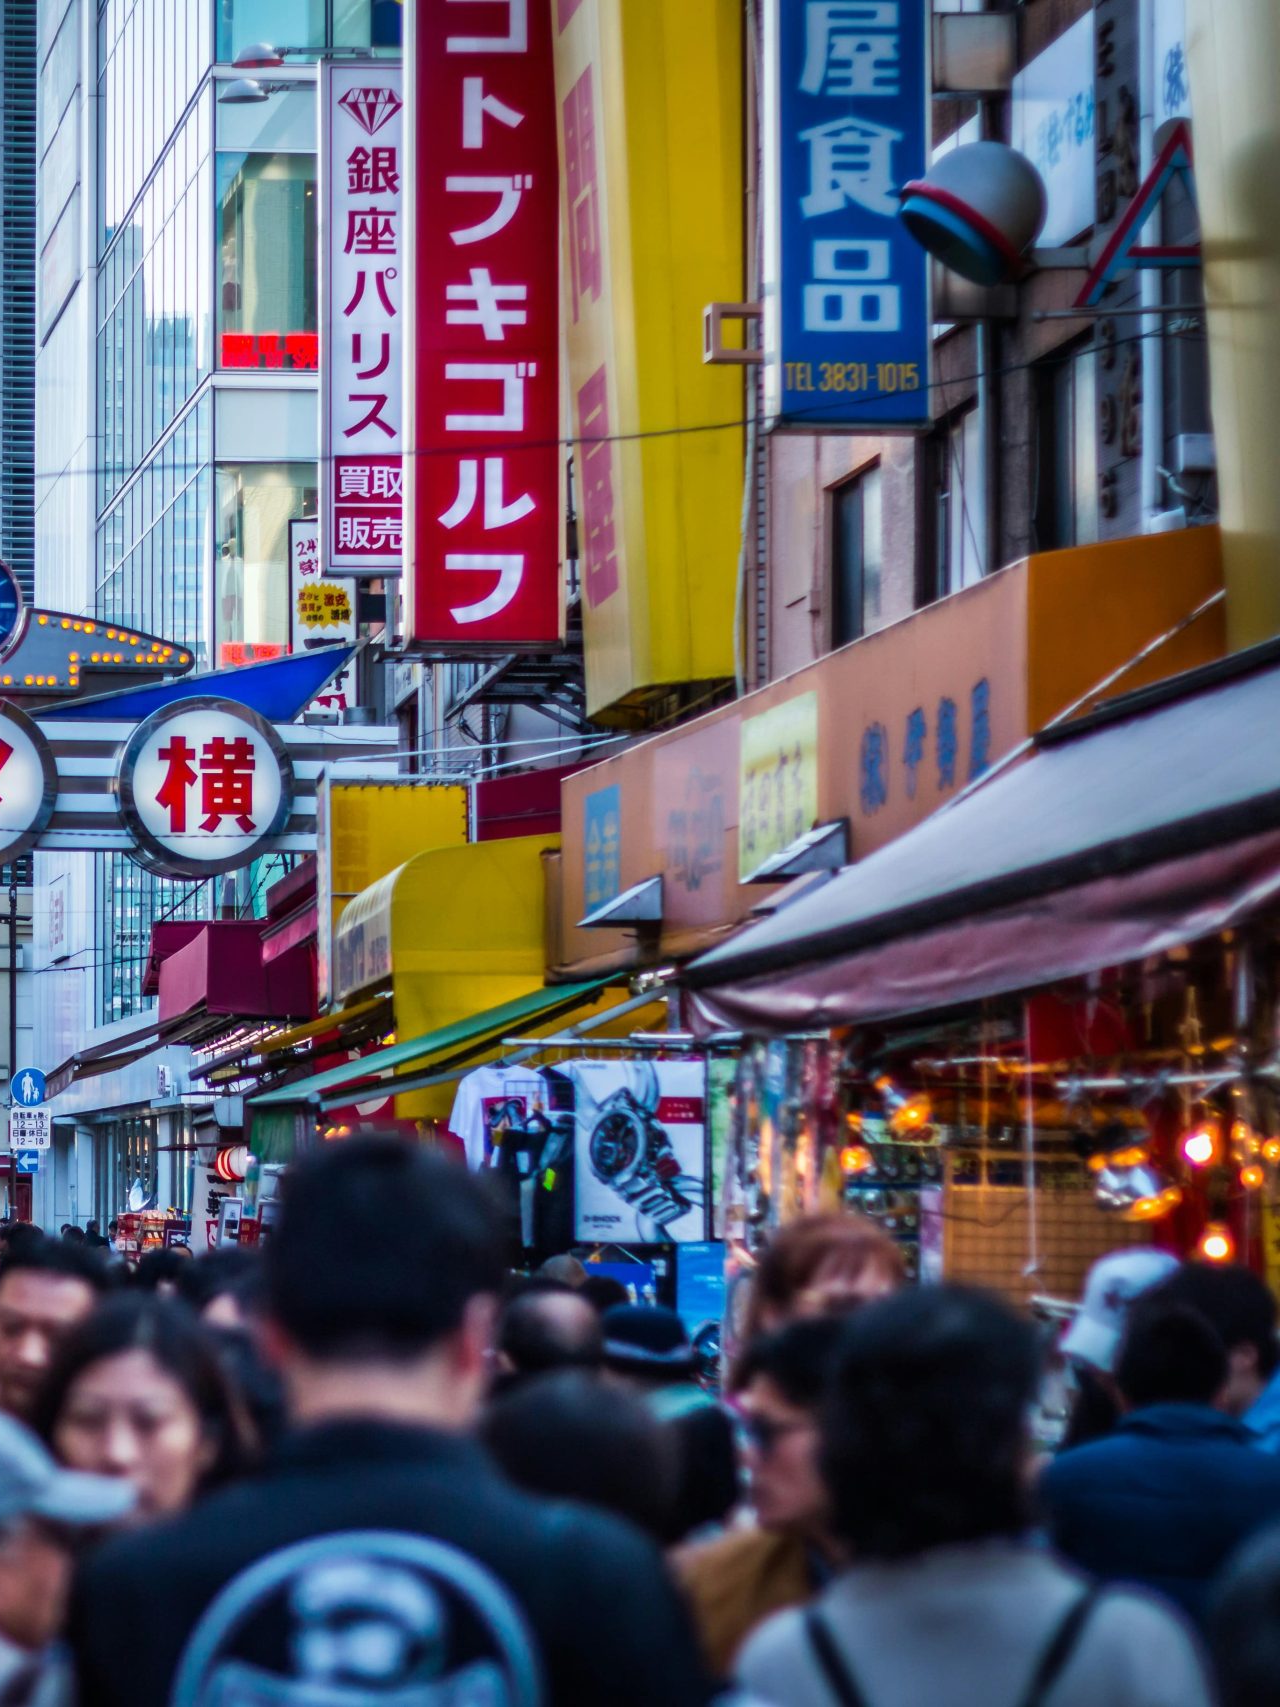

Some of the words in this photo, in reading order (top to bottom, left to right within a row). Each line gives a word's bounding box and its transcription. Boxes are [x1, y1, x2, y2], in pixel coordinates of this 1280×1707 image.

[798, 0, 904, 332] 屋食品
[342, 146, 400, 439] 銀座パリス
[437, 0, 537, 625] コトブキゴルフ
[785, 361, 815, 391] TEL
[819, 362, 919, 392] 3831-1015
[338, 466, 402, 498] 買取
[338, 517, 402, 550] 販売
